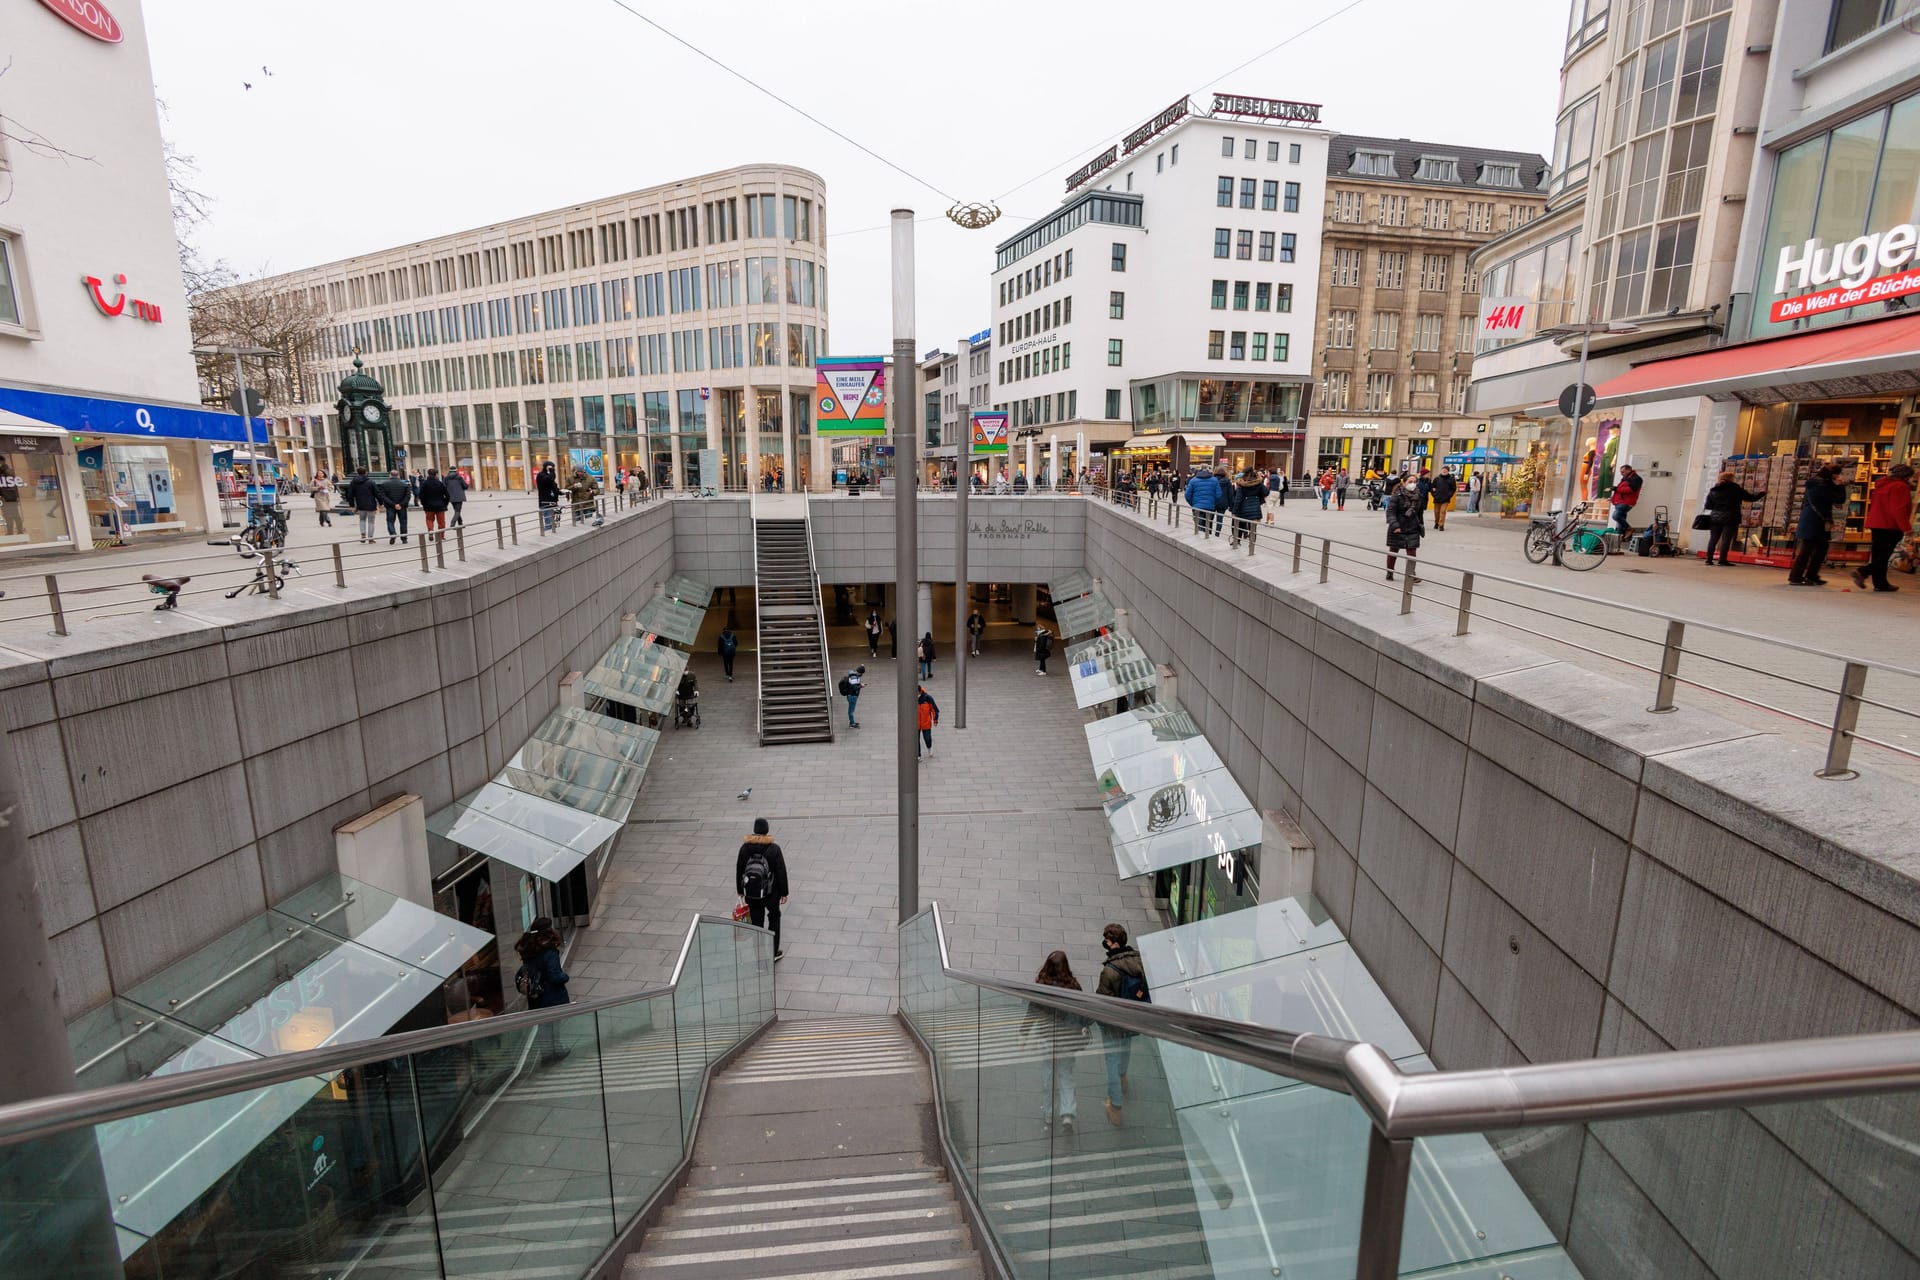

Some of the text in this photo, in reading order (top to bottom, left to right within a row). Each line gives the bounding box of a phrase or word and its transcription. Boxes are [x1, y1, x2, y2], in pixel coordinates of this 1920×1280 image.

[1214, 96, 1320, 120] STIEBEL ELTRON
[1122, 100, 1188, 152] STIEBEL ELTRON
[1774, 224, 1920, 294] Huge
[132, 299, 162, 323] TUI
[1780, 302, 1802, 317] Die
[1805, 294, 1836, 312] Welt
[1840, 289, 1866, 305] der
[1486, 305, 1524, 330] H&M
[1011, 333, 1057, 354] EUROPA-HAUS
[1418, 421, 1432, 433] JD
